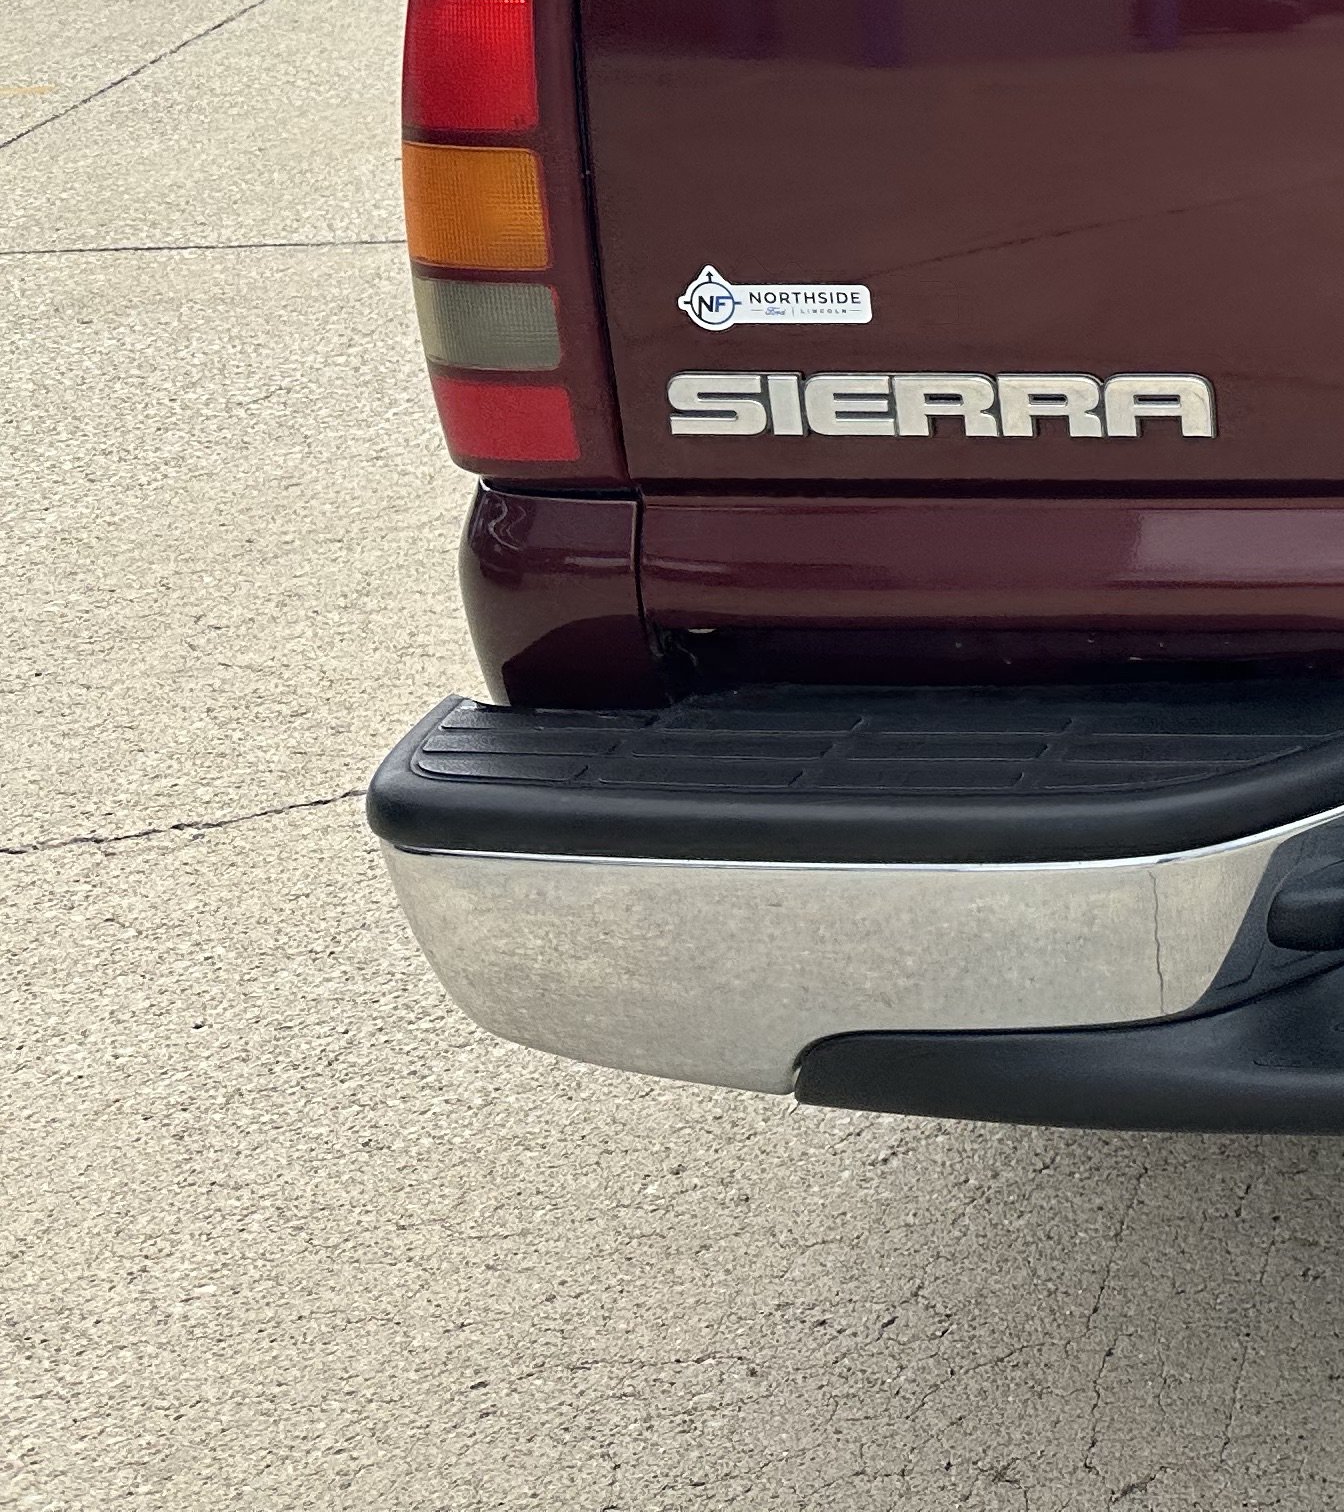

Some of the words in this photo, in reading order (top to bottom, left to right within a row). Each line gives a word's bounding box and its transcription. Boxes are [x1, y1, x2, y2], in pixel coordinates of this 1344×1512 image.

[698, 295, 733, 313] NF
[749, 292, 861, 304] NORTHSIDE
[765, 307, 786, 316] Ford
[667, 371, 1217, 439] SIERRA
